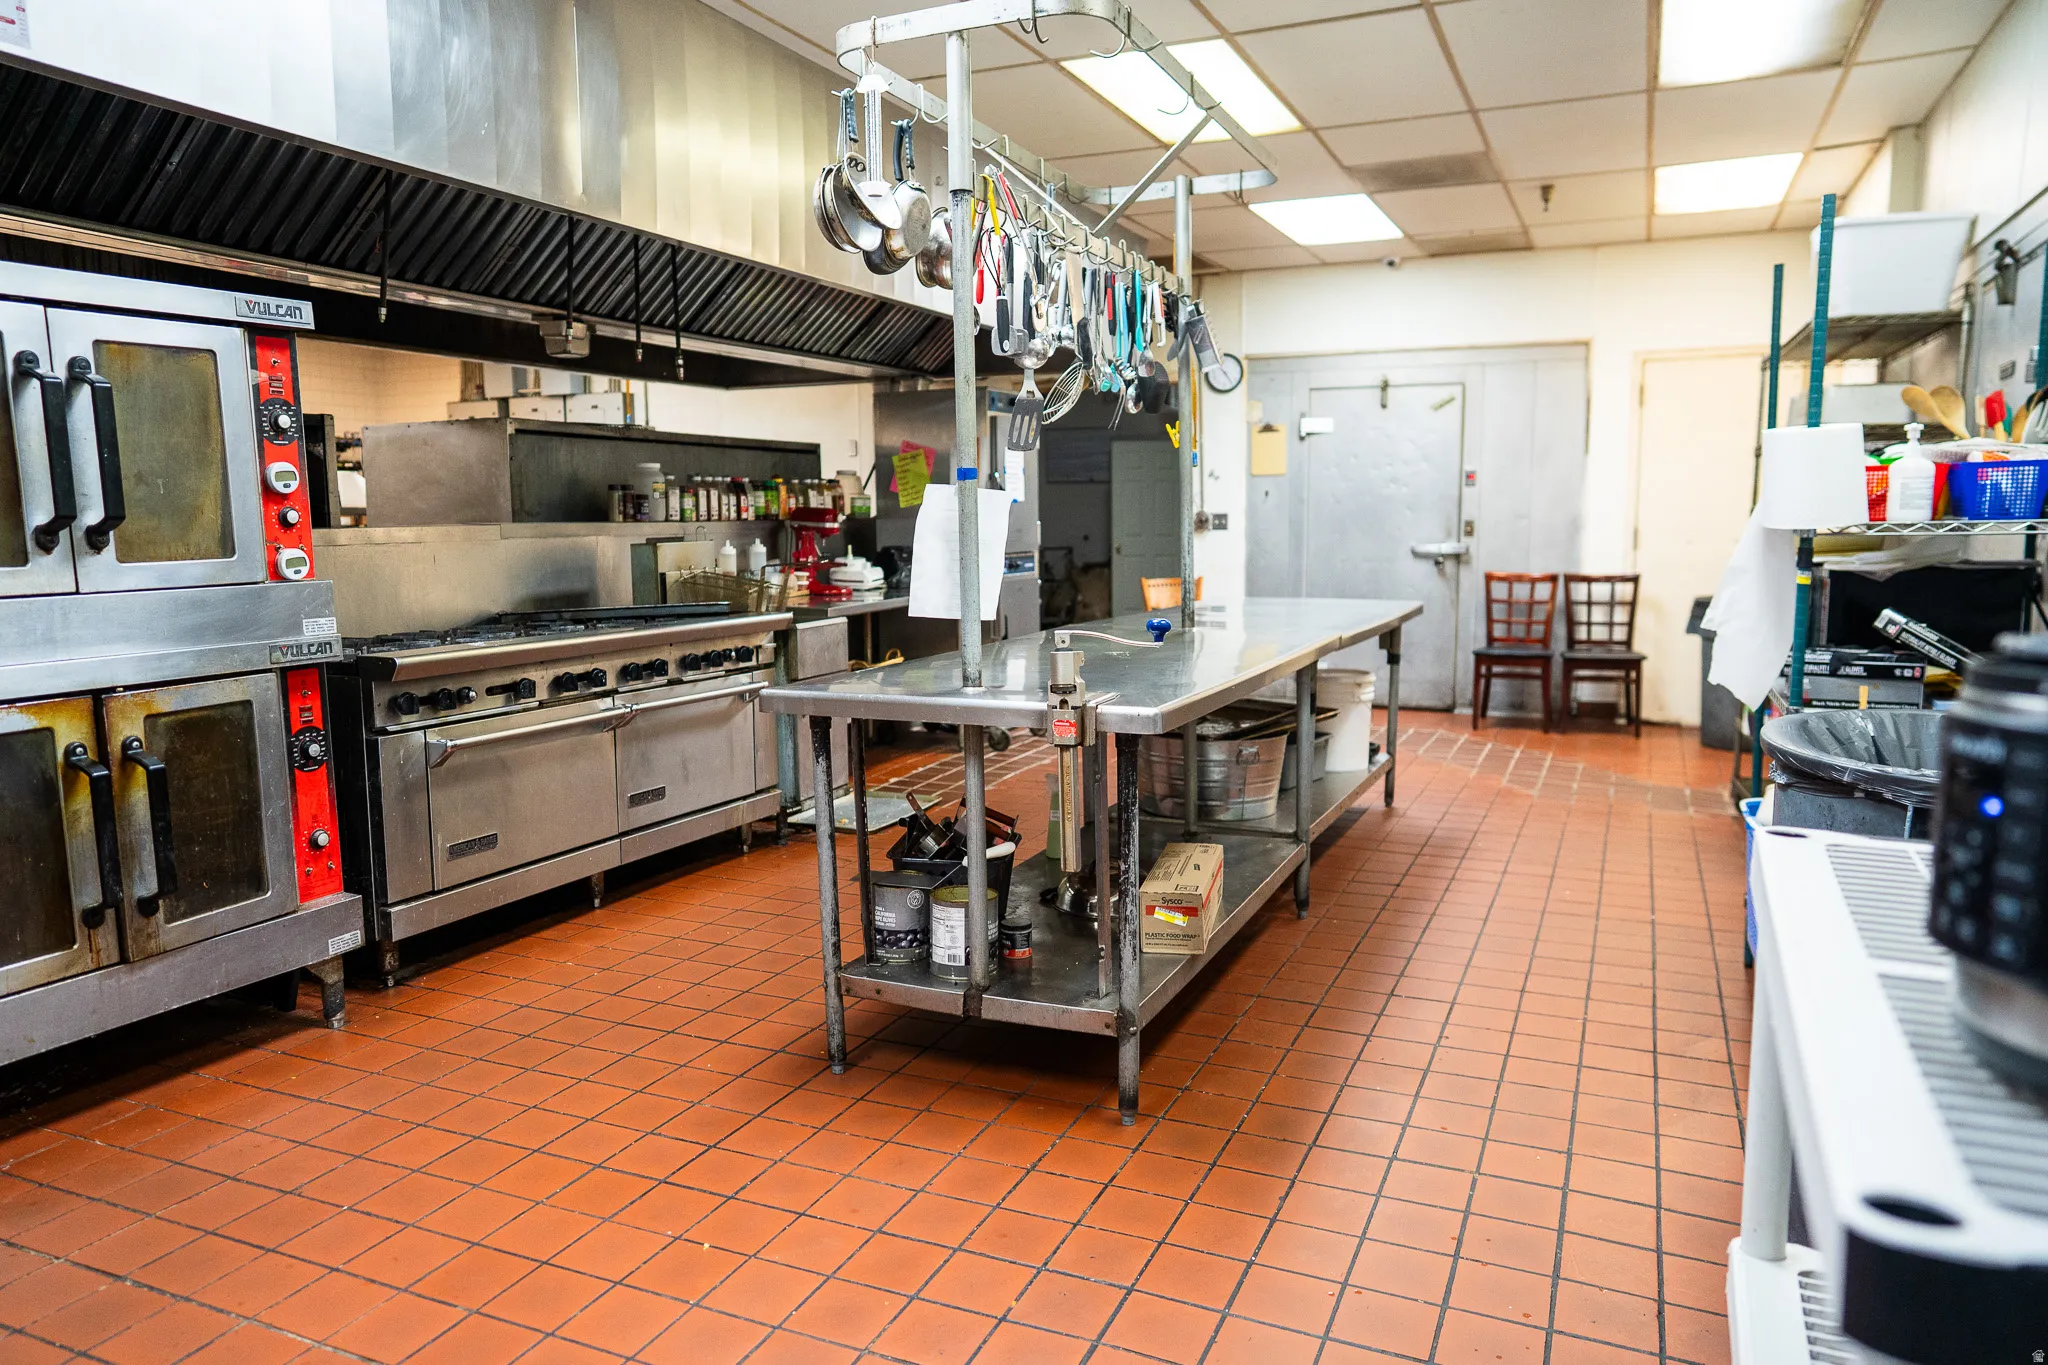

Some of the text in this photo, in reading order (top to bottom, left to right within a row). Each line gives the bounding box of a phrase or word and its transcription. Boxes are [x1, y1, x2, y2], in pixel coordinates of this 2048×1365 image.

[244, 299, 303, 320] VULCAN
[279, 641, 333, 659] VULCAN
[1161, 896, 1183, 906] Sysco
